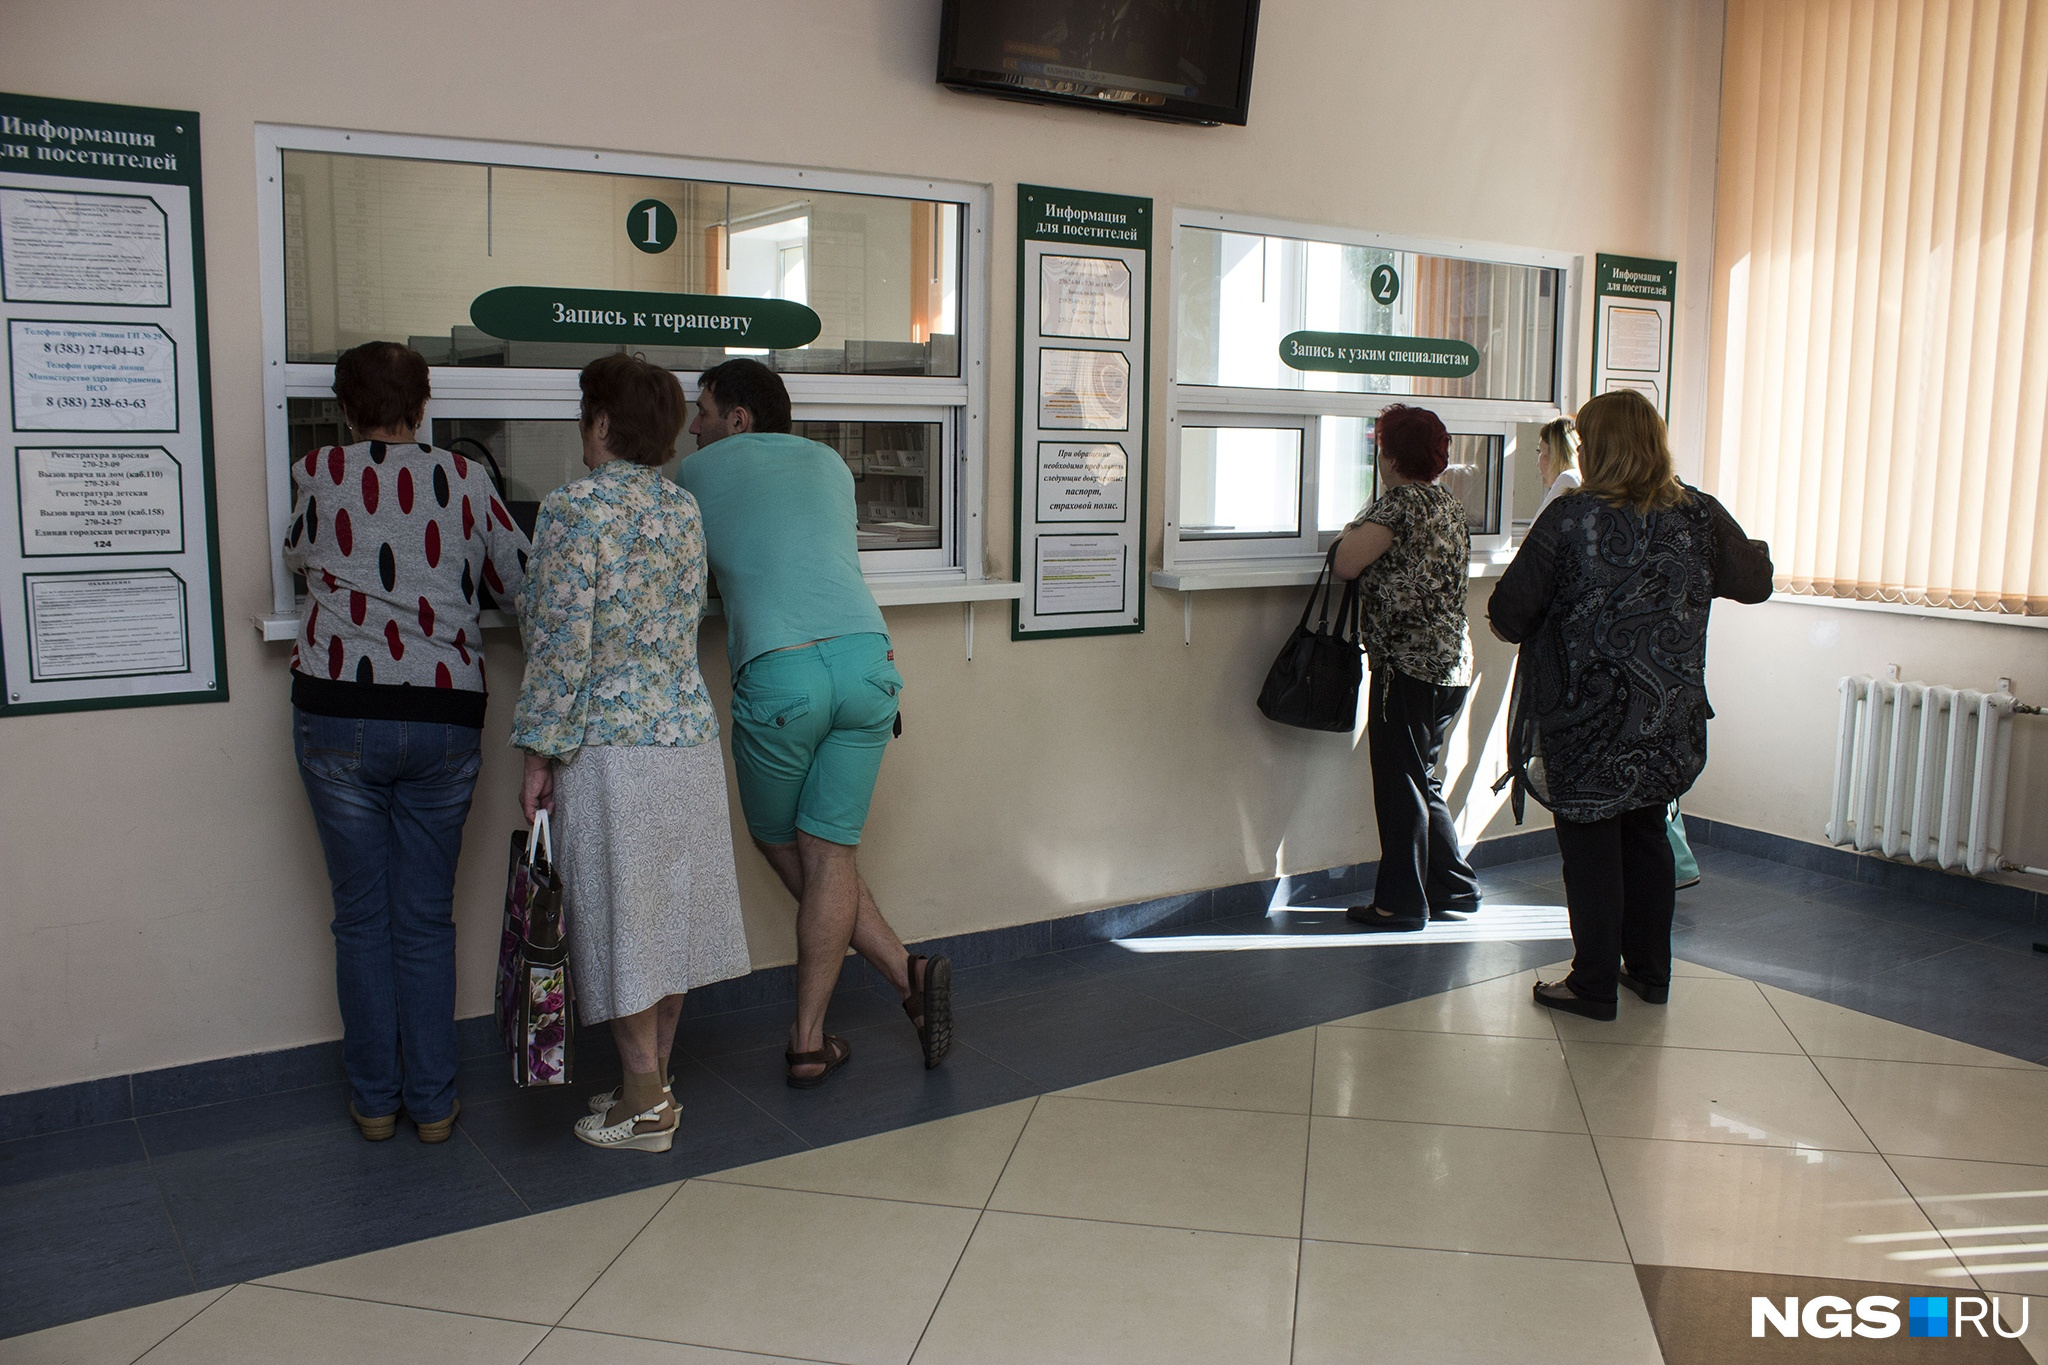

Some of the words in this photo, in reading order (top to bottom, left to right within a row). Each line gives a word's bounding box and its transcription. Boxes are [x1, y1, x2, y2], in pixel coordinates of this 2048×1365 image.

[1, 115, 156, 148] Информация
[0, 143, 29, 159] ля
[38, 146, 178, 171] посетителей
[1045, 203, 1127, 225] Информация
[642, 206, 661, 245] 1
[1036, 222, 1059, 233] для
[1063, 224, 1138, 241] посетителей
[1612, 267, 1661, 283] Информация
[1378, 269, 1392, 299] 2
[1606, 282, 1621, 291] для
[1622, 284, 1667, 296] посетителей
[552, 302, 627, 327] Запись
[633, 311, 647, 327] к
[651, 312, 752, 336] терапевту
[24, 327, 61, 337] Телефон
[44, 343, 51, 352] 8
[55, 343, 85, 356] (383)
[89, 345, 145, 356] 274-04-43
[1290, 340, 1334, 359] Запись
[1338, 347, 1346, 359] к
[1349, 348, 1386, 363] узким
[1389, 350, 1469, 366] специалистам
[46, 361, 81, 370] Телефон
[46, 397, 53, 407] 8
[57, 397, 87, 409] (383)
[91, 398, 147, 409] 238-63-63
[51, 451, 109, 460] Регистратура
[1057, 449, 1072, 459] При
[1043, 462, 1083, 470] необходимо
[126, 470, 163, 478] (каб.110)
[1043, 475, 1081, 483] следующие
[55, 490, 113, 499] Регистратура
[1065, 489, 1102, 497] паспорт,
[1049, 502, 1092, 511] страховой
[1093, 502, 1118, 510] полис.
[70, 510, 95, 518] врача
[35, 529, 67, 537] Единая
[69, 529, 112, 537] городская
[115, 528, 170, 536] регистратура
